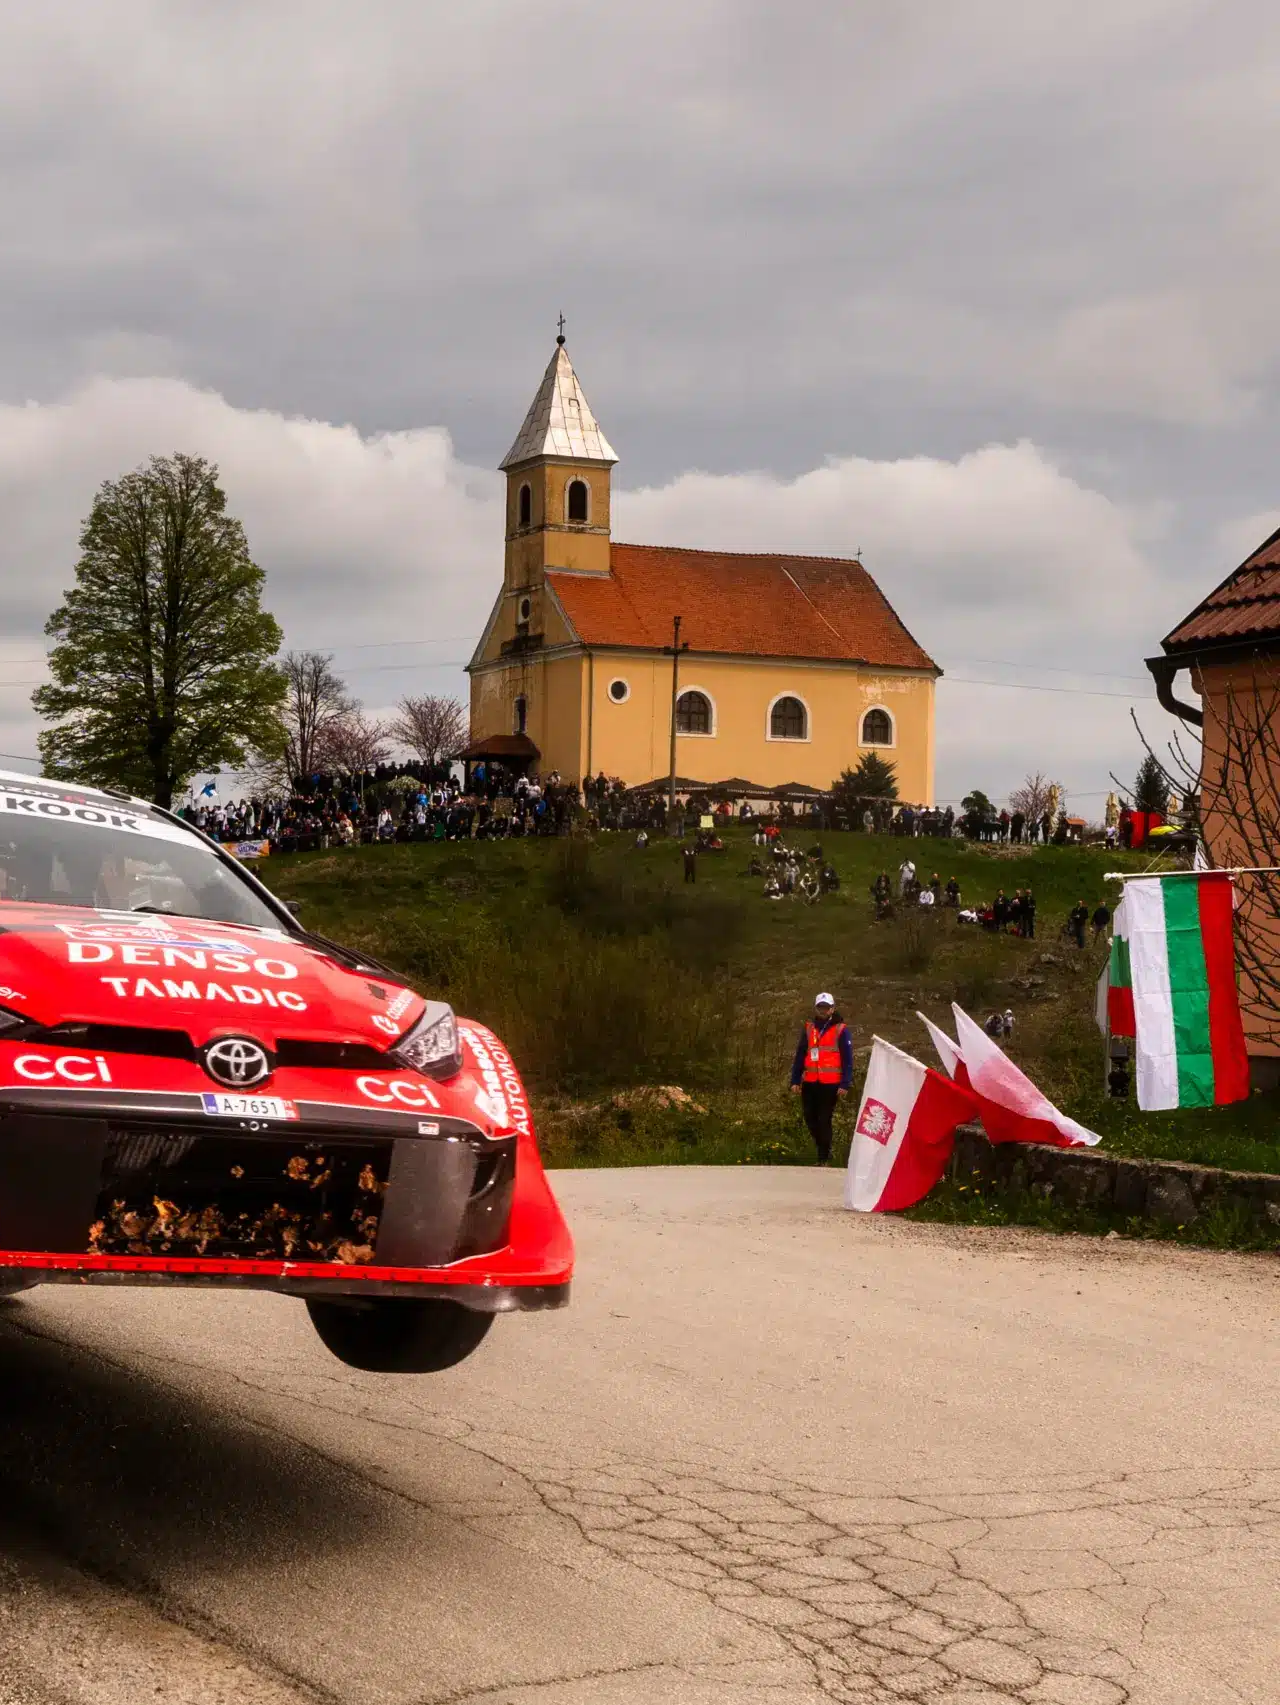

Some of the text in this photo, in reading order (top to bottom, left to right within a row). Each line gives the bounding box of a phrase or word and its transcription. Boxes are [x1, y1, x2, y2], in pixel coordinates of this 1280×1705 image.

[66, 942, 299, 980] DENSO
[100, 977, 308, 1012] TAMADIC
[224, 1098, 278, 1115] A-7651
